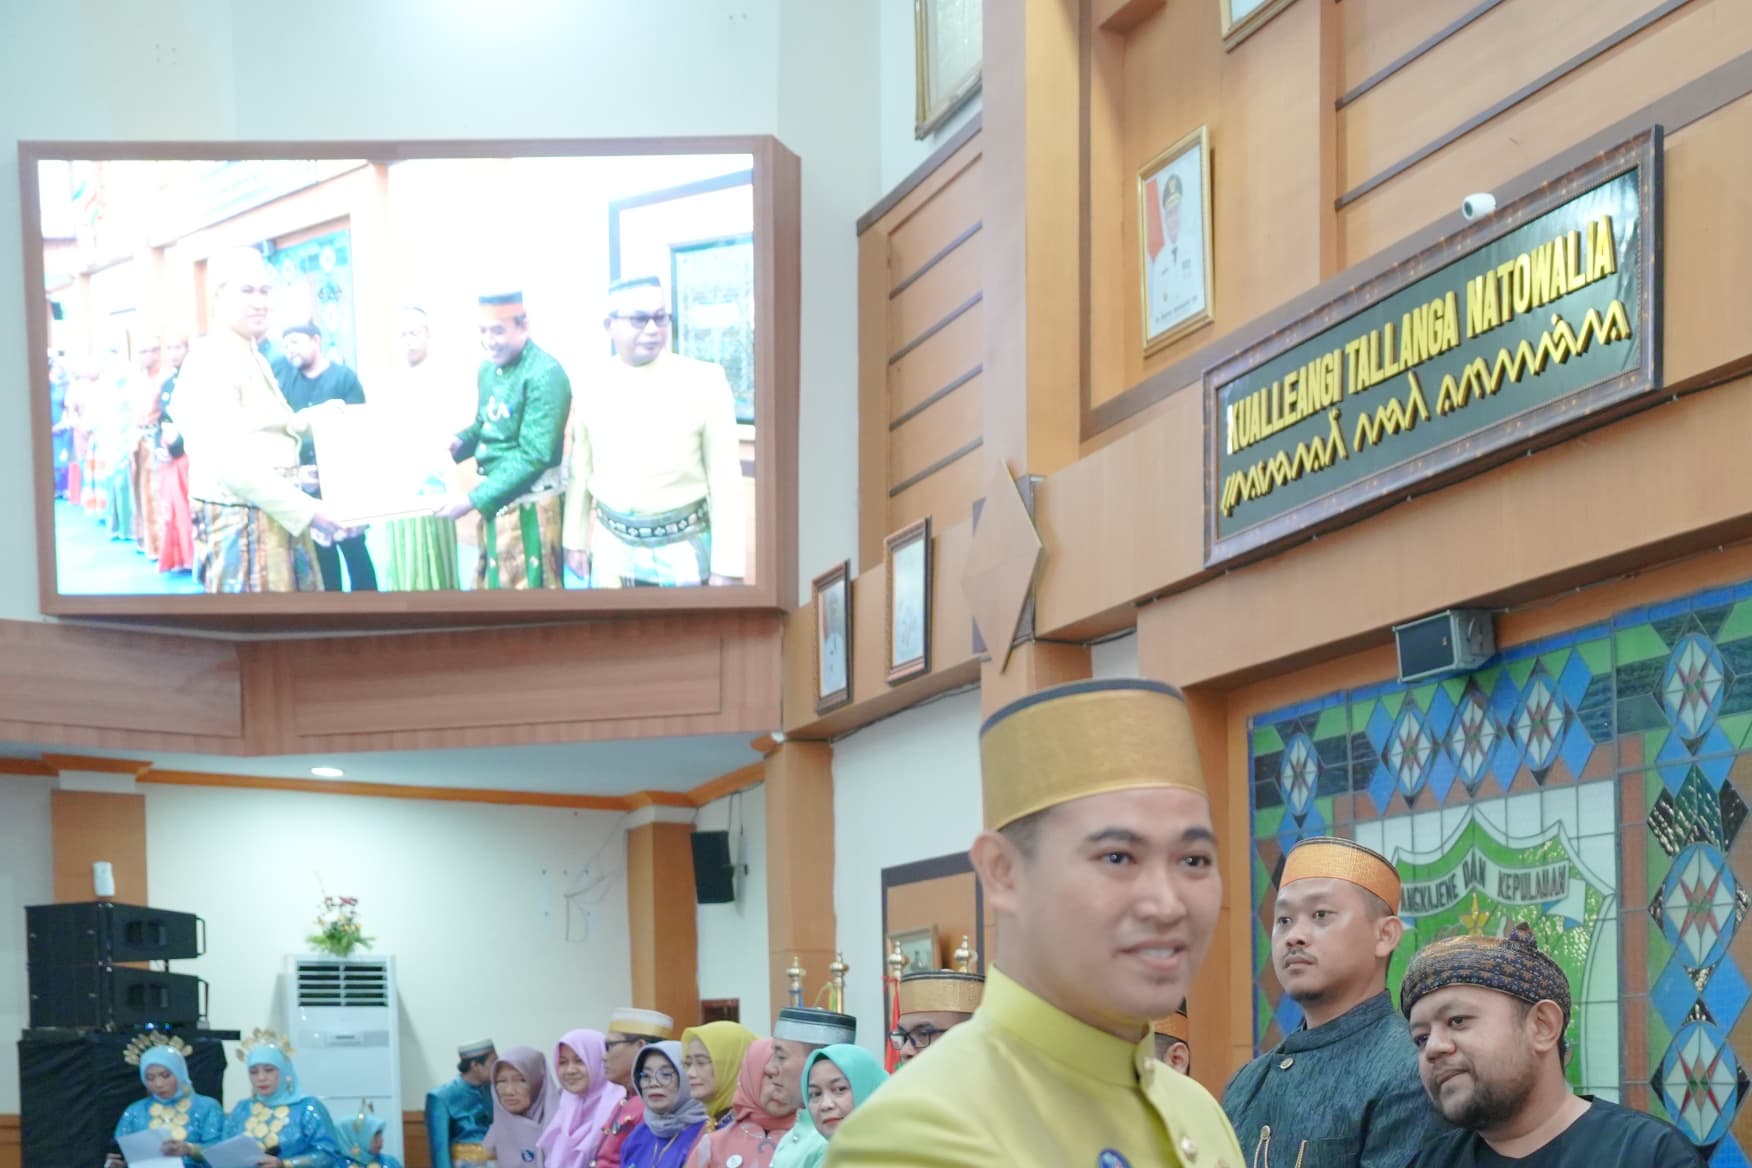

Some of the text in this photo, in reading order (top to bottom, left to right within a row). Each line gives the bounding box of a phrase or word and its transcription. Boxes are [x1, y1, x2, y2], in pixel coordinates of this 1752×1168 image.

[1225, 214, 1618, 456] KUALLEANGI TALLANGA NATOWALIA
[1400, 872, 1459, 913] ANGKAJENE
